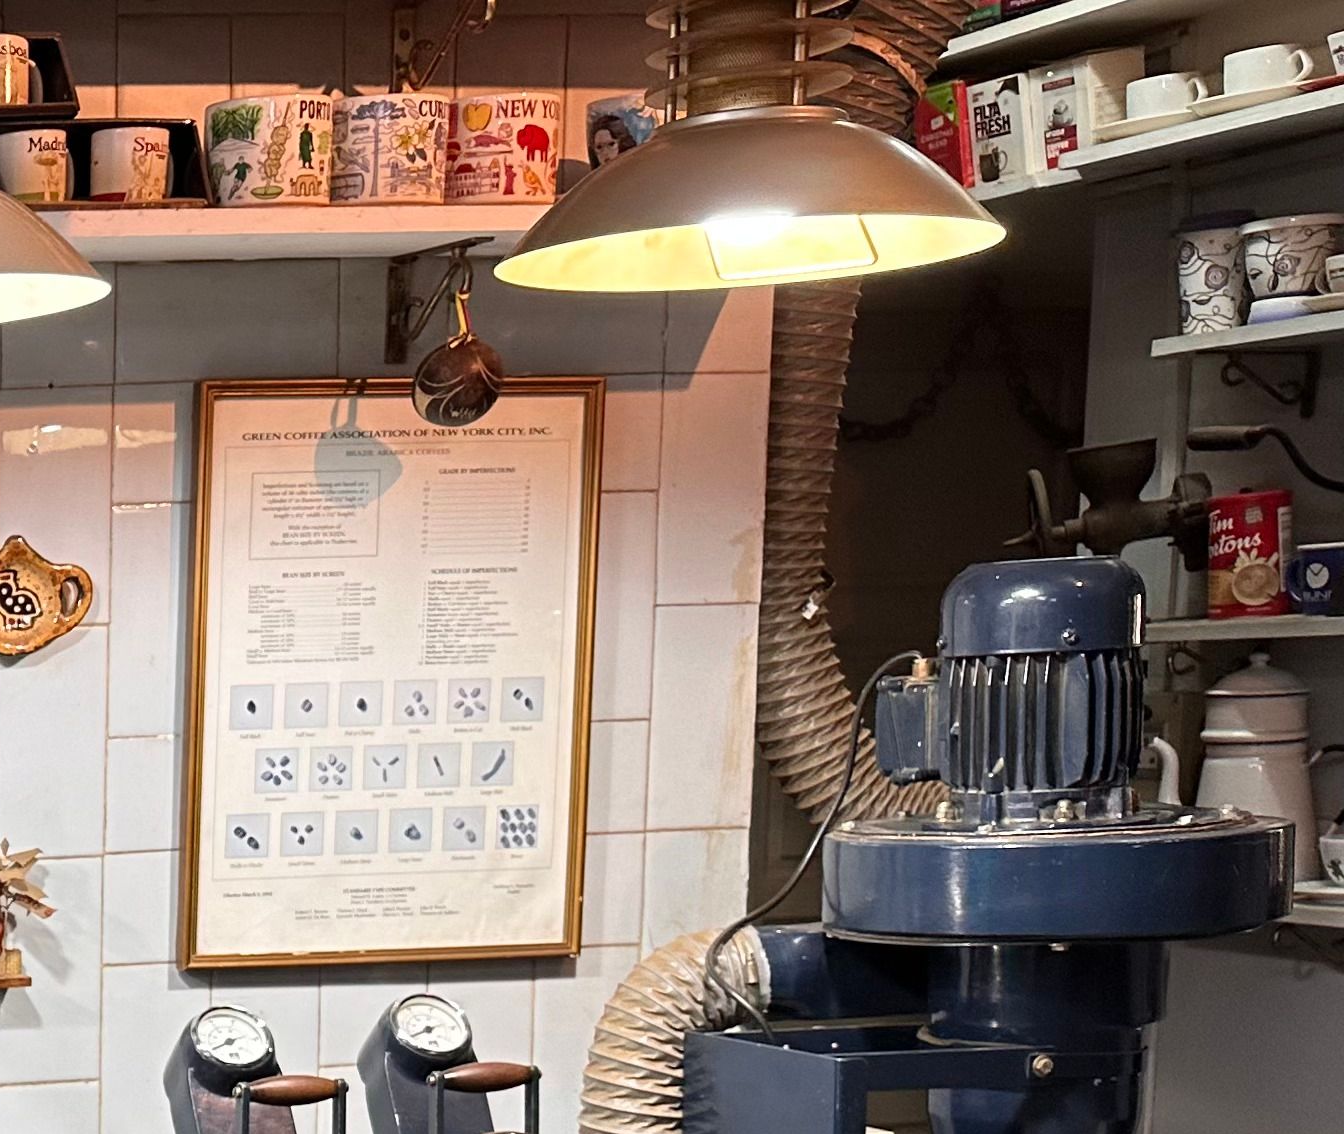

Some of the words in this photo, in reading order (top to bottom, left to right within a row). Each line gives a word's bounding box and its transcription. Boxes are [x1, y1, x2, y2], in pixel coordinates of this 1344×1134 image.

[495, 99, 535, 119] NEW
[973, 101, 1001, 123] FILTA
[974, 114, 1011, 140] FRESH
[242, 432, 282, 441] GREEN
[283, 431, 327, 440] COFFEE
[329, 428, 411, 439] ASSOCIATION
[413, 428, 429, 437] OF
[431, 428, 459, 437] NEW
[462, 427, 495, 436] YORK
[528, 426, 553, 435] INC.
